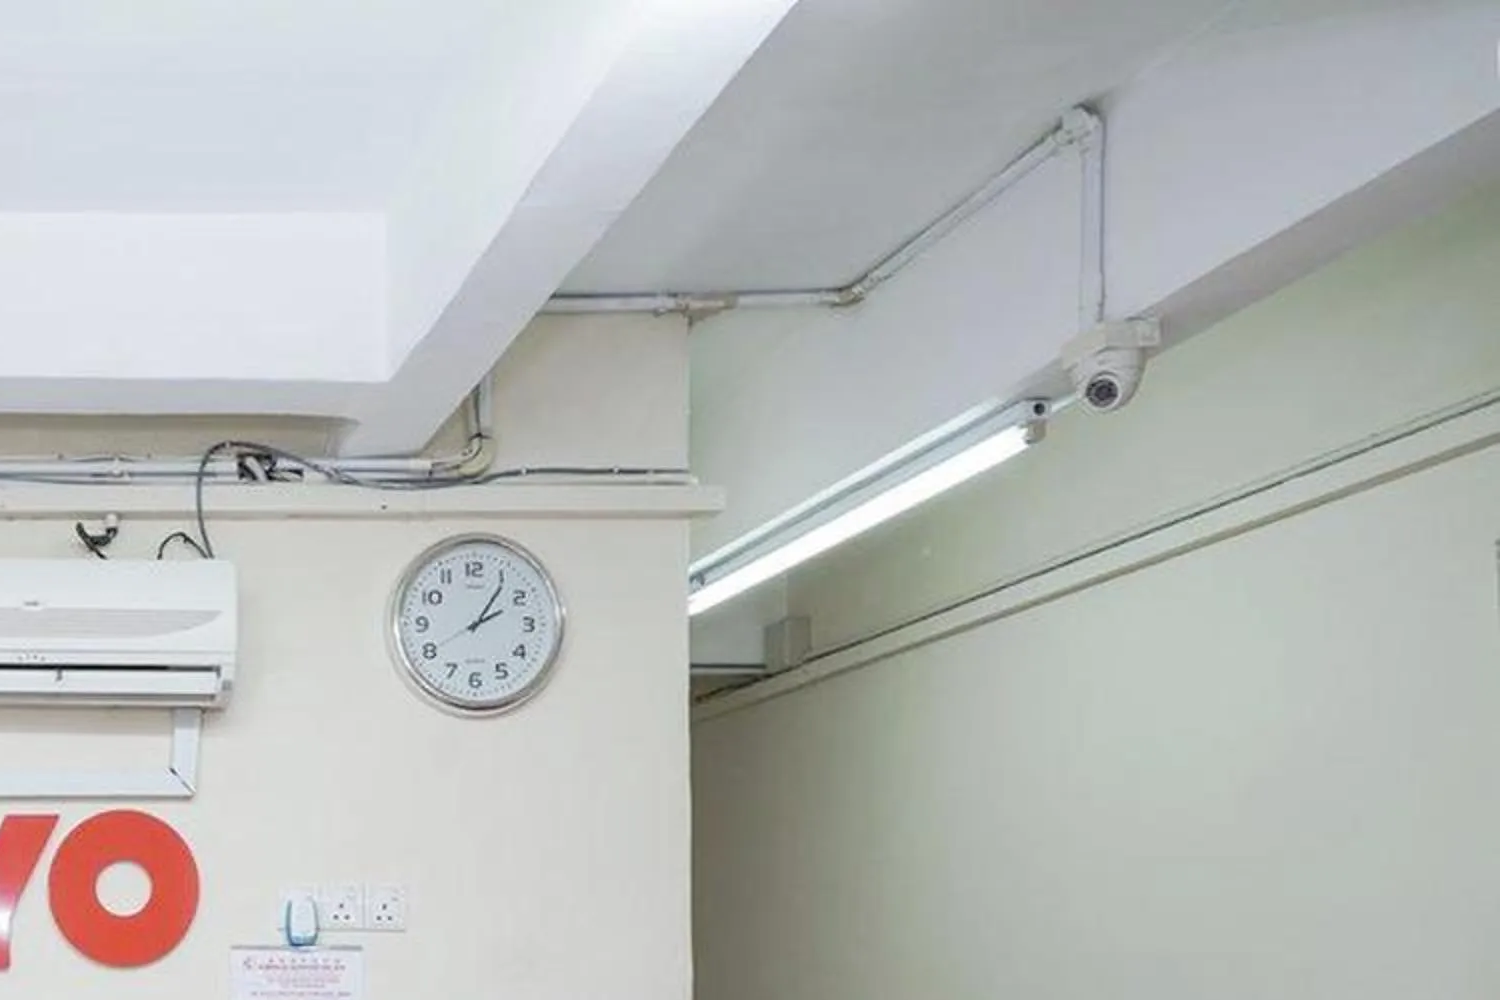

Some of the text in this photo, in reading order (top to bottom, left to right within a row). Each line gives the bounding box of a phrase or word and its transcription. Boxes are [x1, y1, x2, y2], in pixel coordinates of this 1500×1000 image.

[439, 568, 453, 584] 11
[464, 562, 484, 578] 12
[421, 589, 443, 605] 10
[513, 589, 527, 606] 2
[415, 615, 430, 632] 9
[522, 616, 536, 633] 3
[422, 643, 437, 660] 8
[512, 643, 526, 660] 4
[444, 663, 459, 679] 7
[495, 662, 509, 679] 5
[468, 672, 482, 689] 6
